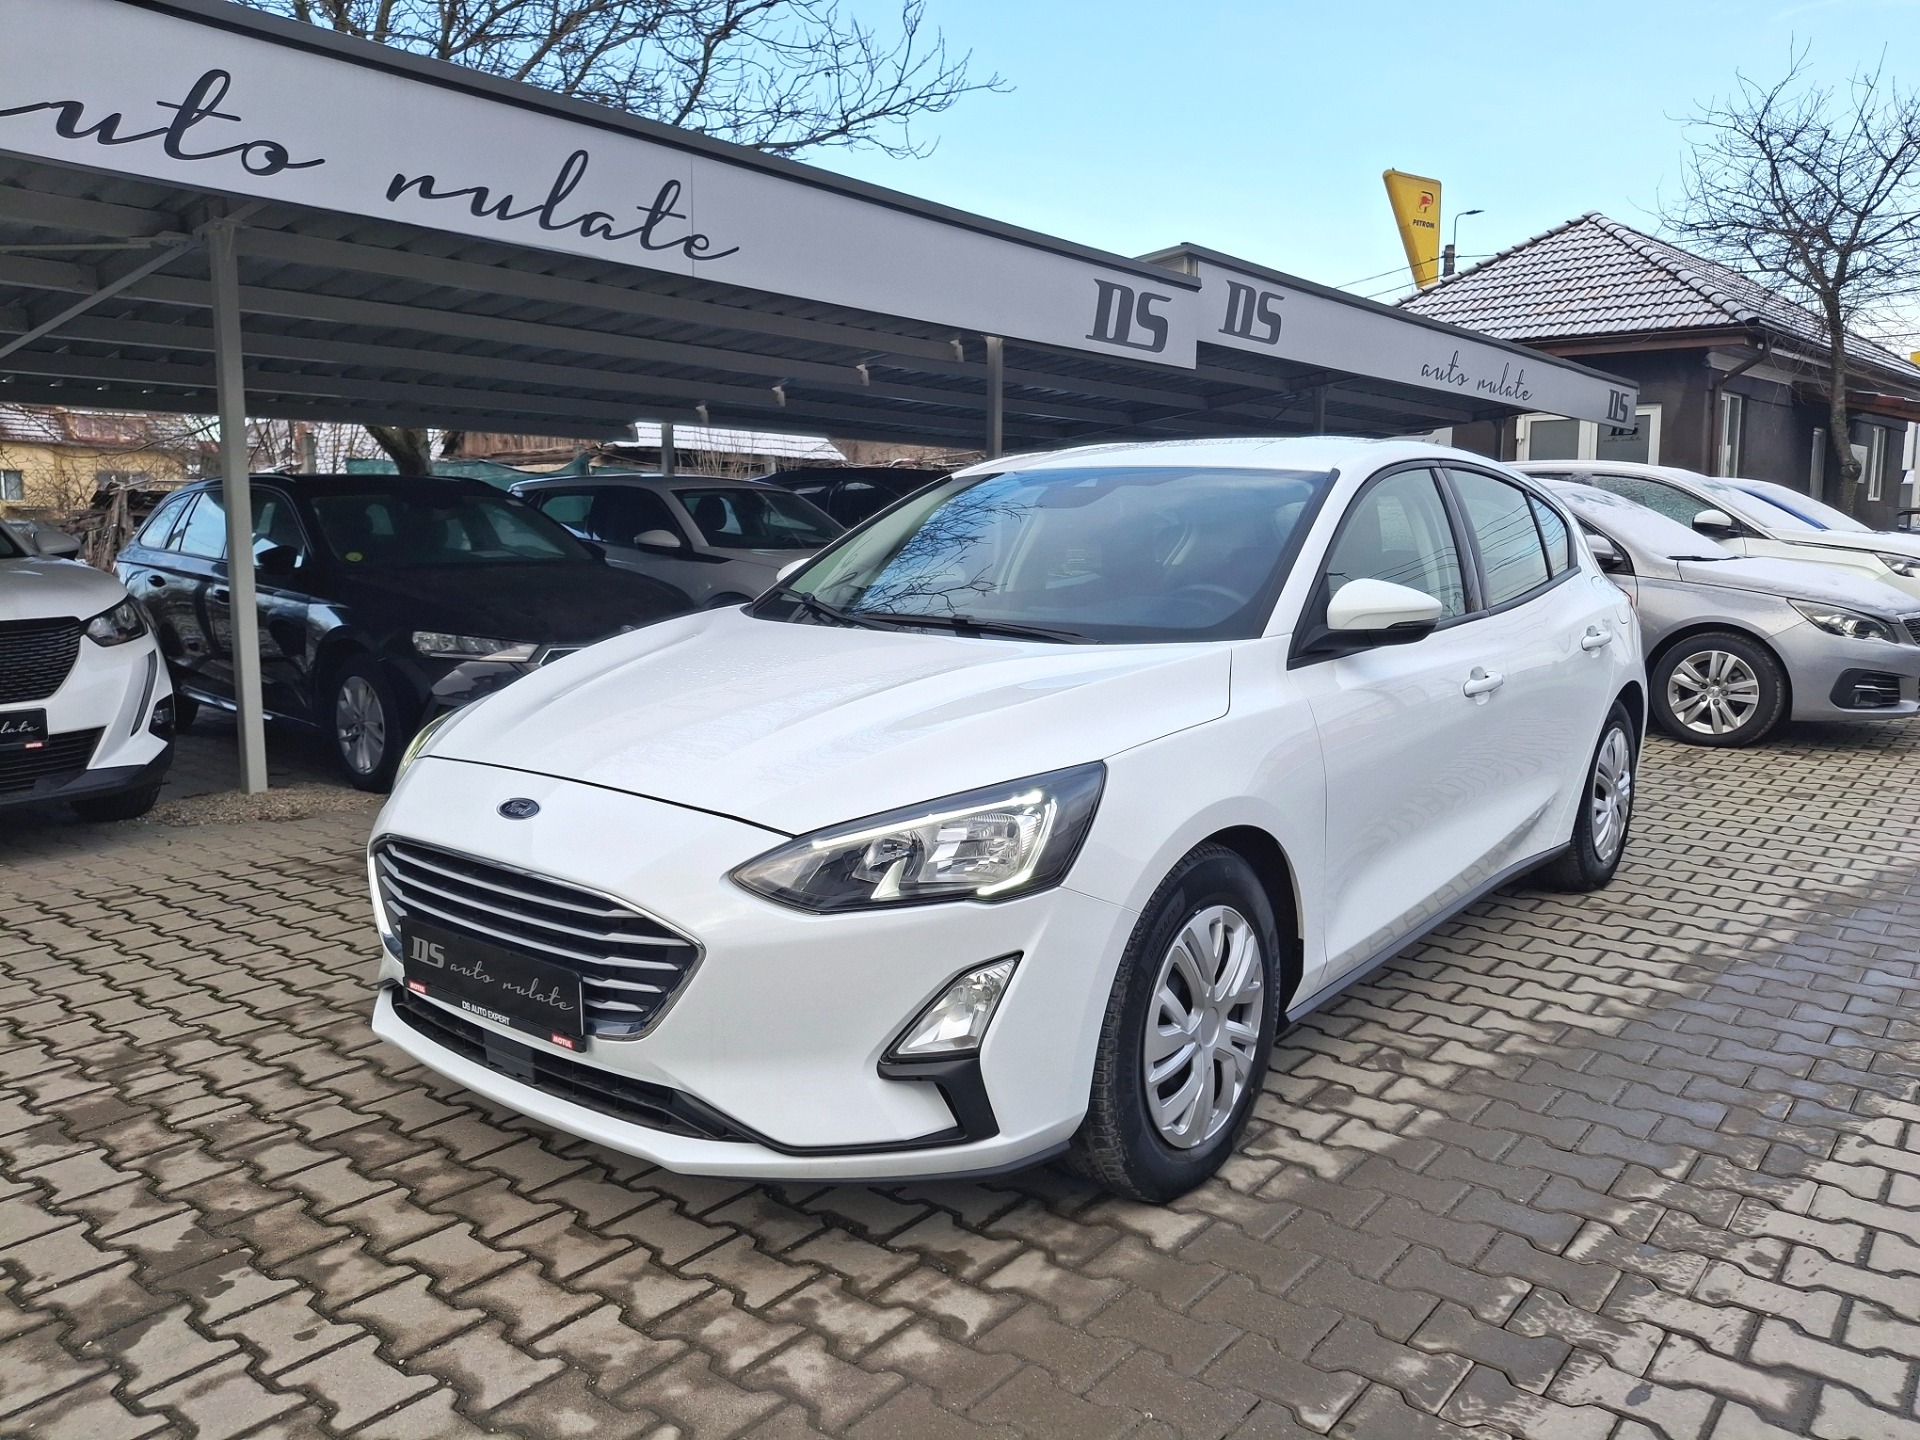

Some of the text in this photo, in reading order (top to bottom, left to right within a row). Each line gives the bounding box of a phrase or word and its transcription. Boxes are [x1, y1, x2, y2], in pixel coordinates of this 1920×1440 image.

[0, 69, 740, 260] uto nulate
[1412, 219, 1435, 229] PETROM
[1085, 278, 1173, 353] DS
[1218, 280, 1629, 423] DS auto nulate DS
[0, 721, 39, 734] late
[410, 935, 574, 1010] DS auto nulate
[462, 1000, 510, 1025] DS AUTO EXPERT
[552, 1035, 573, 1049] MOTUL
